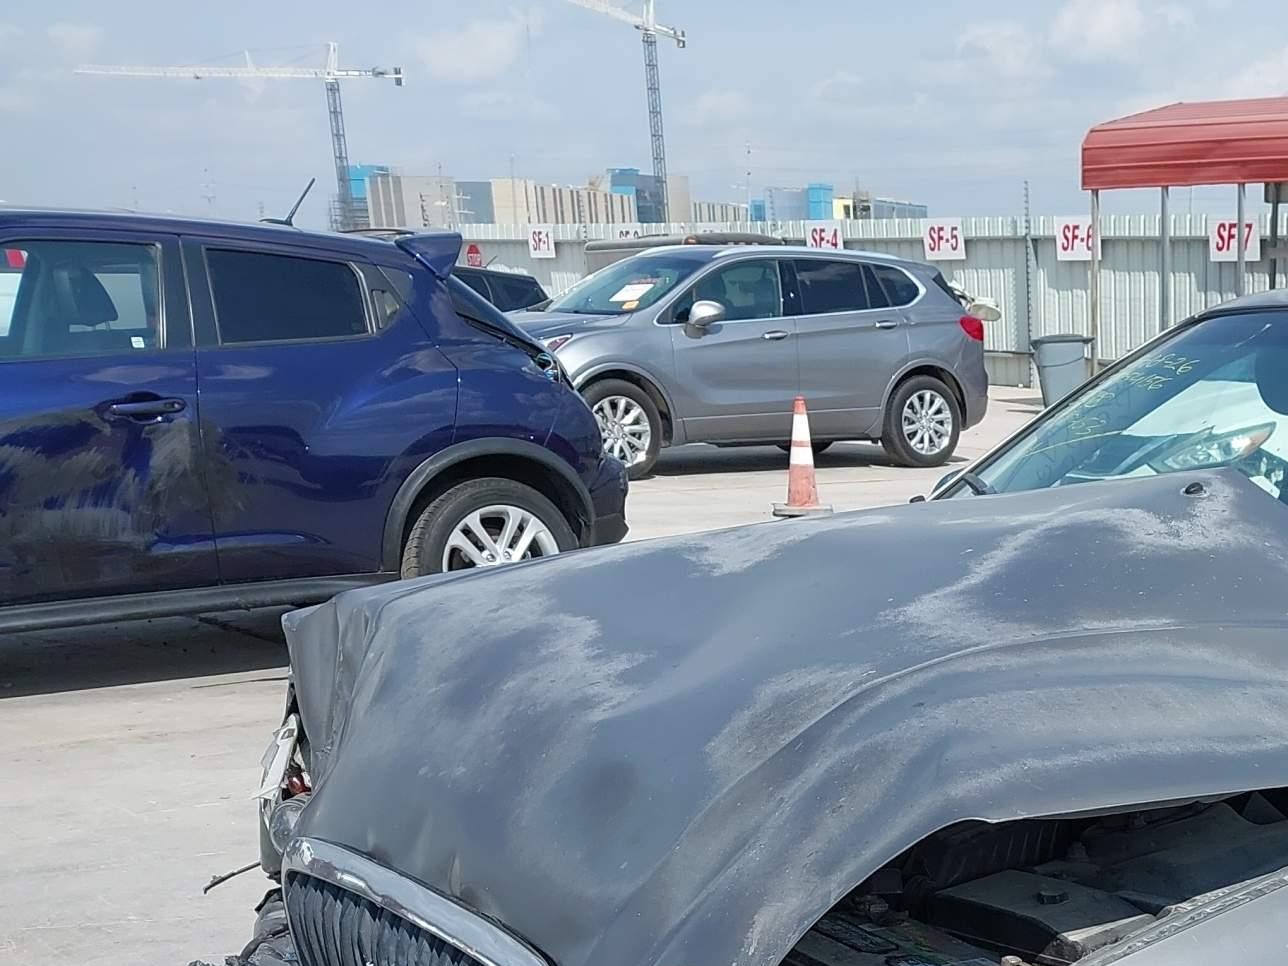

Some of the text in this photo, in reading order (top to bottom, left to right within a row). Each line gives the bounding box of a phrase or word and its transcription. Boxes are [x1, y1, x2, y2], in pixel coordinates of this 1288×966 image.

[532, 231, 550, 251] SF-1
[811, 228, 838, 248] SF-4
[928, 226, 958, 252] SF-5
[1216, 223, 1253, 252] SF7
